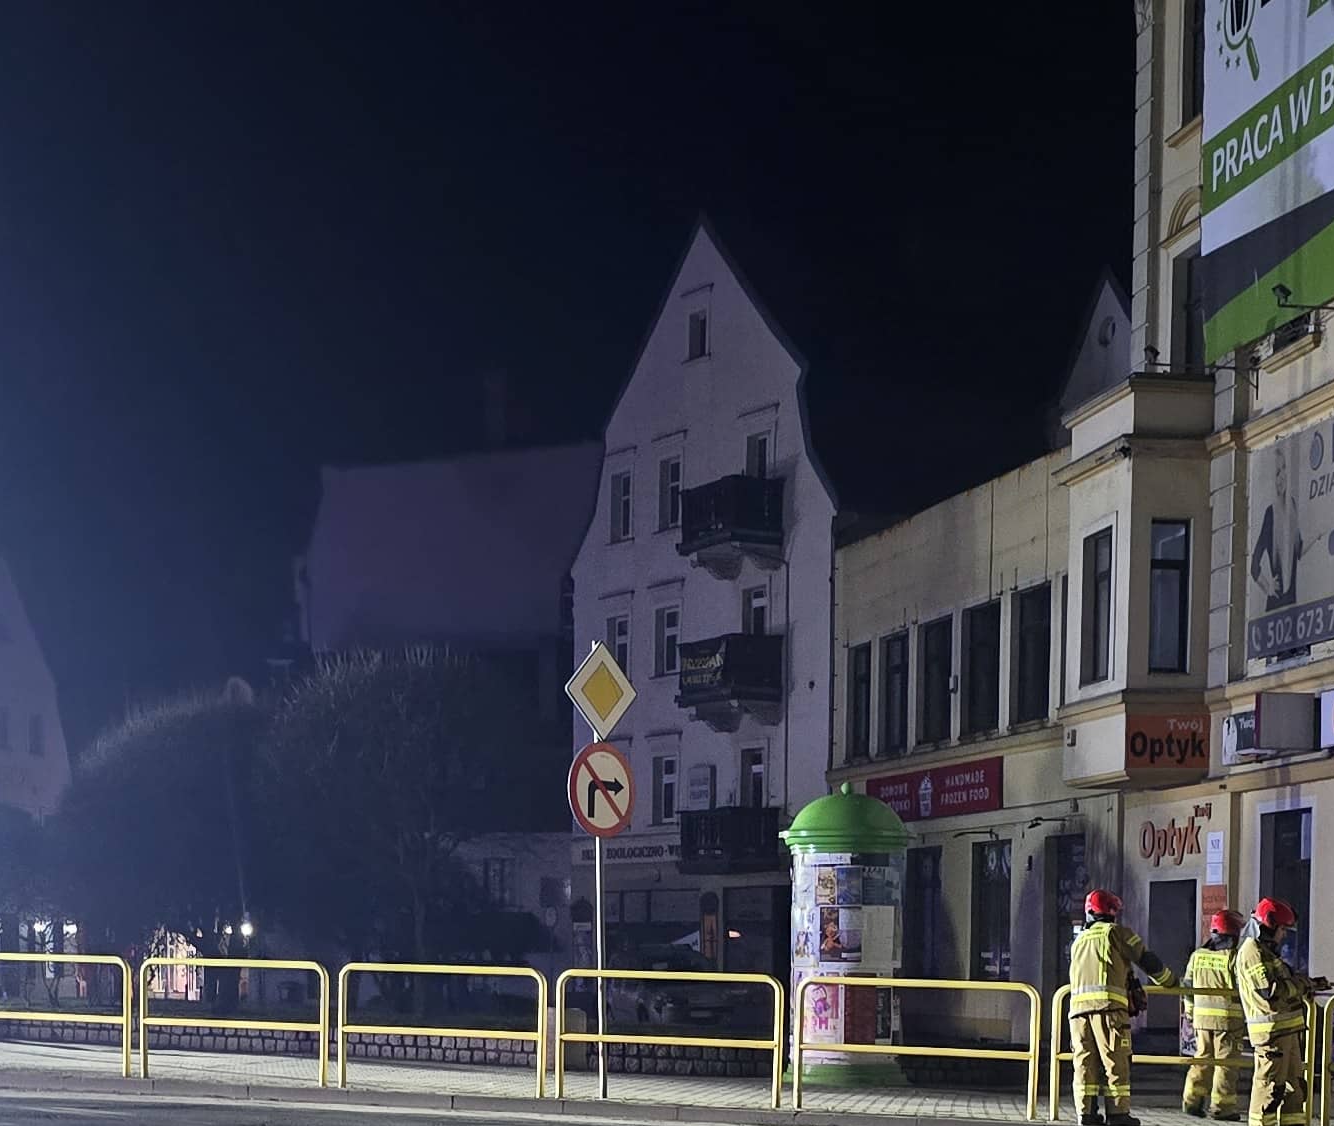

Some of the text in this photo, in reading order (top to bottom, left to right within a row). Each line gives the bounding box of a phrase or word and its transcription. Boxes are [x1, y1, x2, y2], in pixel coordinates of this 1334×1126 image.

[1212, 104, 1284, 193] PRACA
[1289, 77, 1315, 134] W
[1266, 616, 1293, 649] 502
[1296, 606, 1325, 640] 673
[1168, 718, 1204, 733] Twój
[1130, 731, 1205, 764] Optyk
[969, 787, 990, 801] FOOD
[1139, 816, 1202, 867] Optyk
